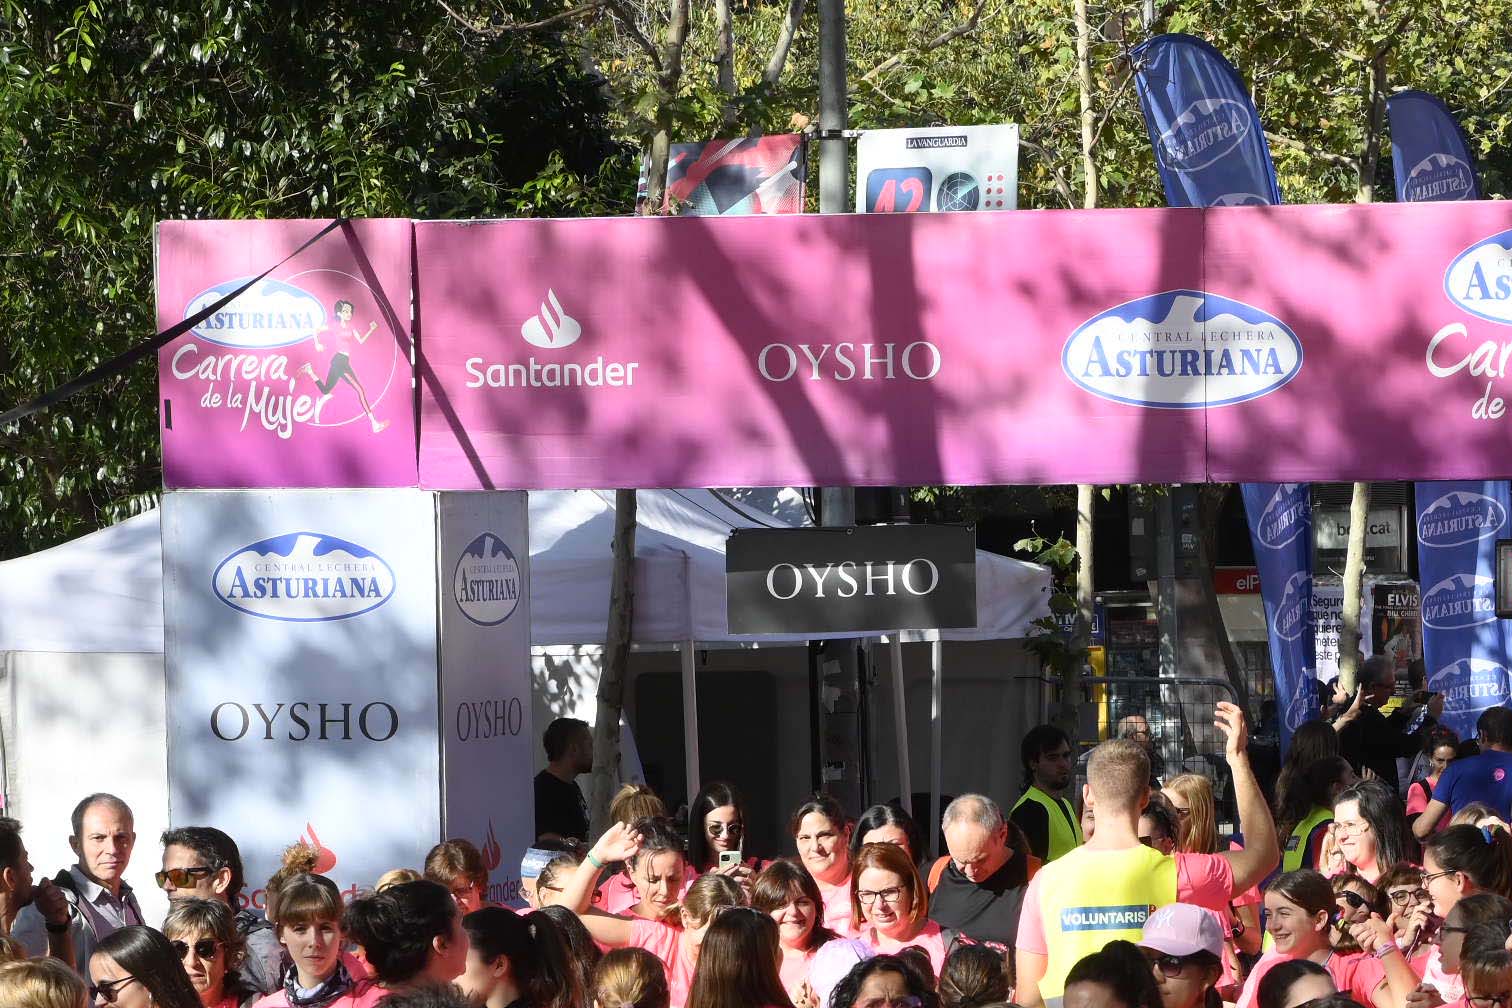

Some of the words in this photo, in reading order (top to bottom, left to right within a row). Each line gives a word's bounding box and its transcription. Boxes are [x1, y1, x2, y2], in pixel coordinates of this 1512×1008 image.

[918, 136, 966, 147] VANGUARDIA
[1117, 331, 1192, 342] CENTRAL
[171, 343, 288, 380] Carrera
[466, 357, 639, 389] Santander
[758, 341, 941, 382] OYSHO
[1082, 335, 1284, 378] ASTURIANA
[200, 382, 222, 408] de
[227, 382, 243, 408] la
[240, 377, 333, 440] Mujer
[1471, 381, 1506, 420] de
[227, 566, 383, 599] ASTURIANA
[459, 568, 518, 603] ASTURIANA
[766, 558, 940, 601] OYSHO
[1387, 593, 1418, 607] ELVIS
[1314, 624, 1343, 635] quiere
[210, 701, 399, 742] OYSHO
[456, 697, 523, 742] OYSHO
[1062, 910, 1147, 926] VOLUNTARIS
